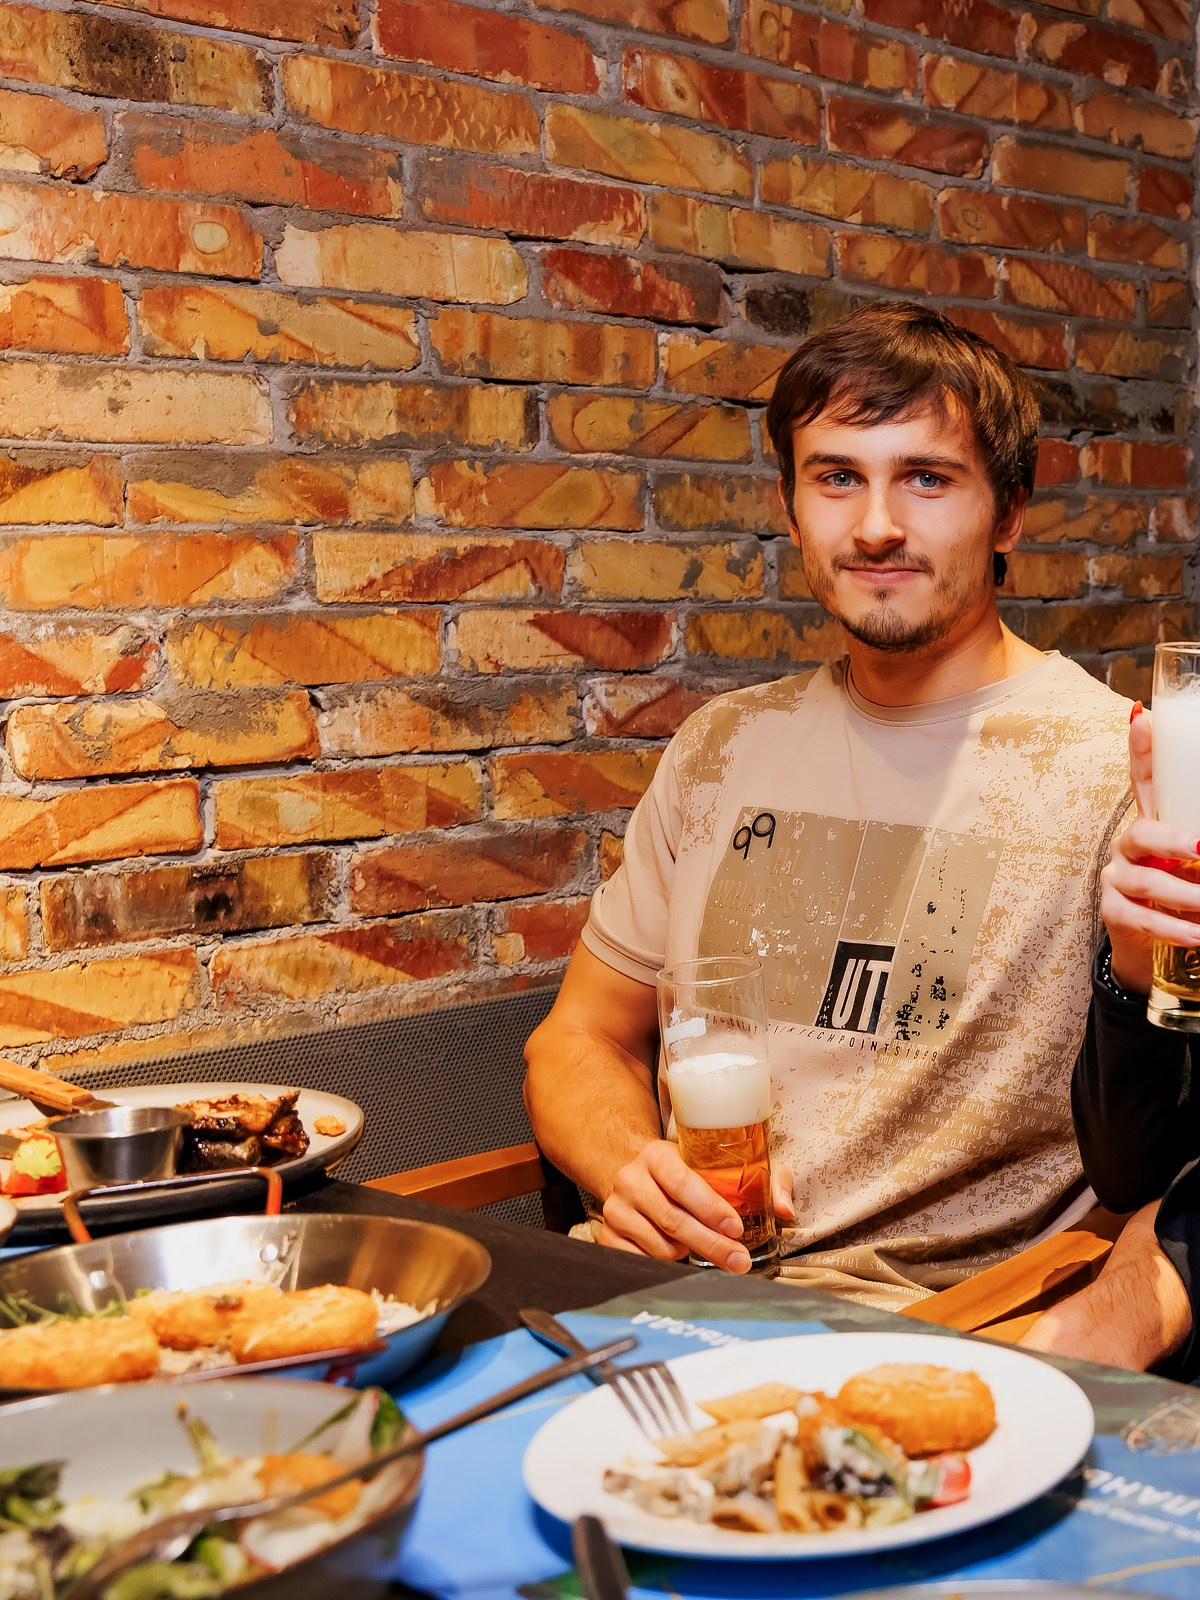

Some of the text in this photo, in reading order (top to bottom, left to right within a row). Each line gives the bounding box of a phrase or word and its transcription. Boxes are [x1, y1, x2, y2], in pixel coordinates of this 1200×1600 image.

[733, 812, 777, 860] 99
[831, 957, 892, 1032] UT
[976, 1015, 1009, 1031] STRONG
